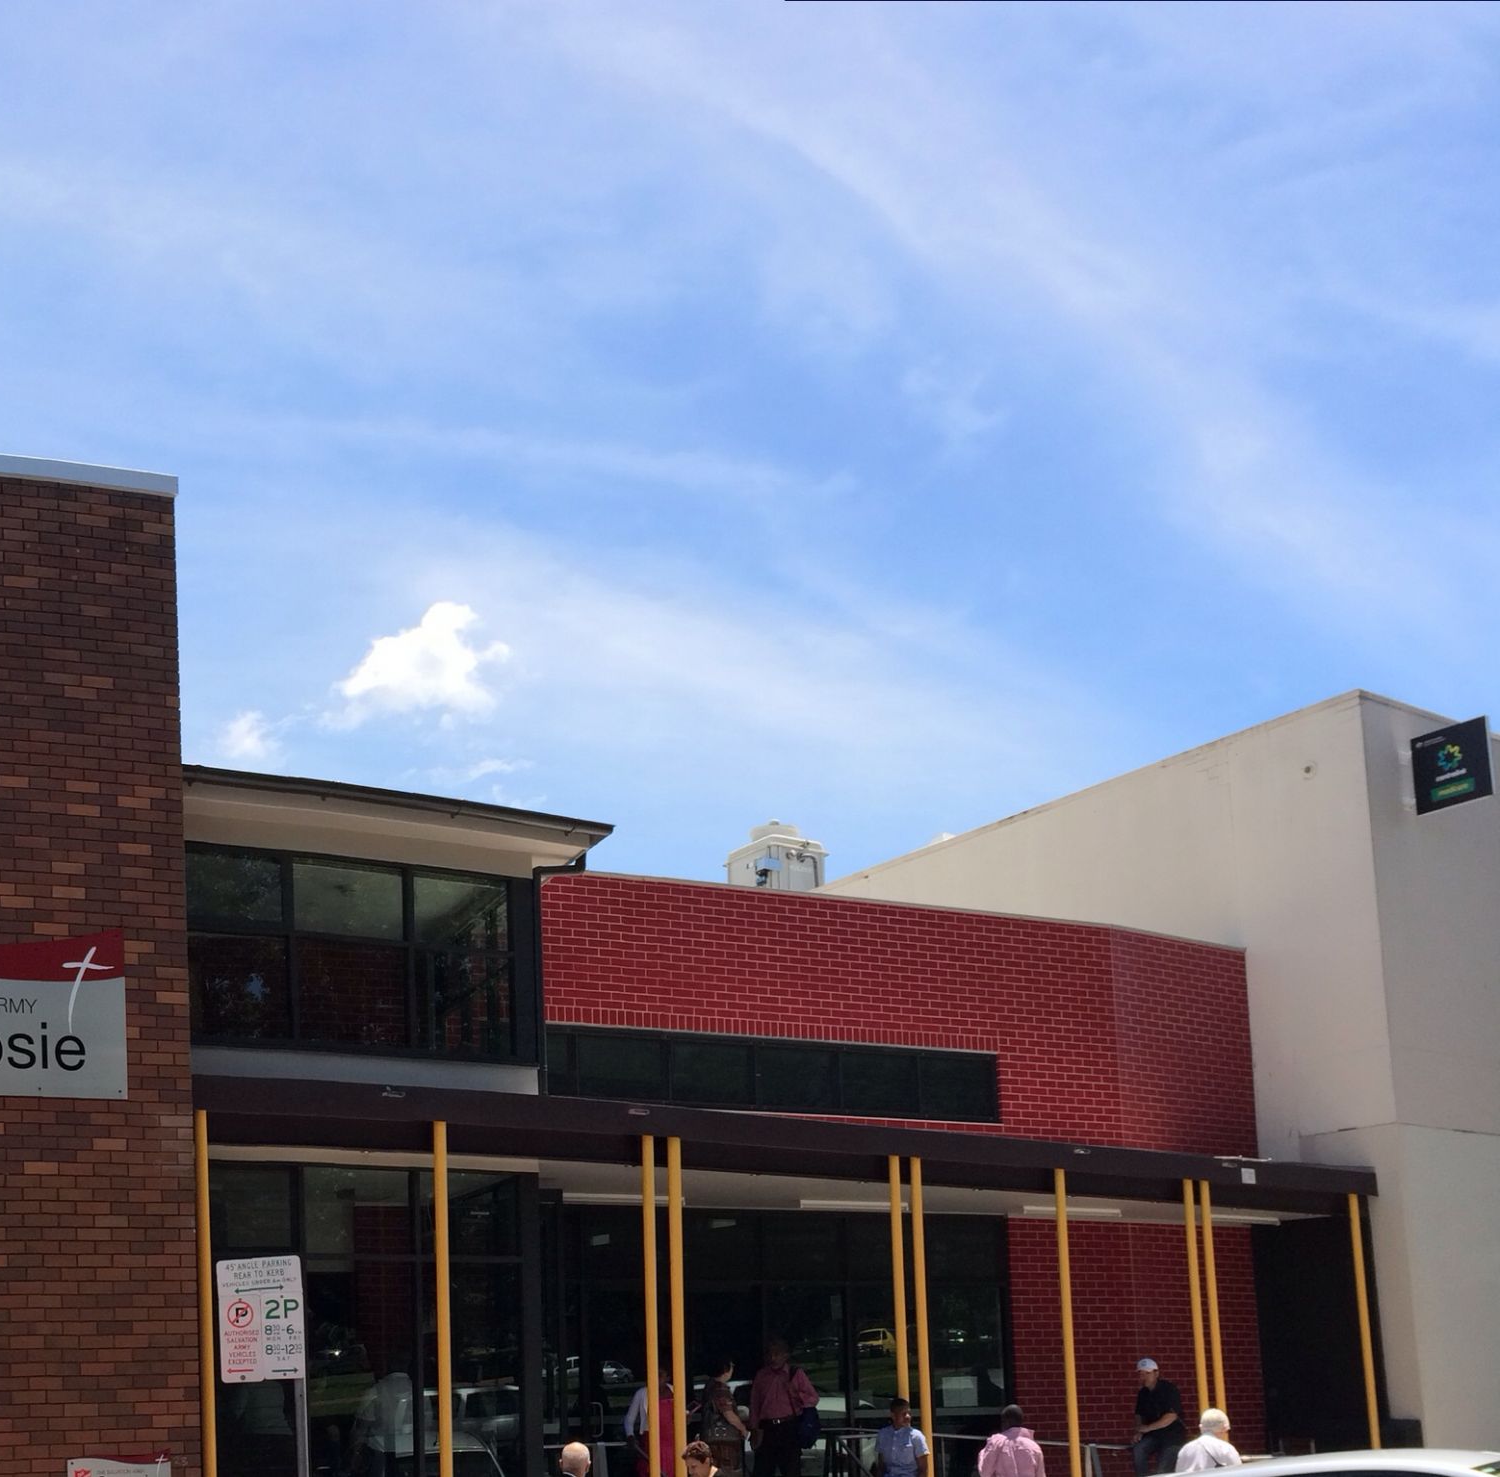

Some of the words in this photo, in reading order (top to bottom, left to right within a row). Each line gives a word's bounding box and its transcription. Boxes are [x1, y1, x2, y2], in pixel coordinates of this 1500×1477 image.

[261, 1259, 292, 1268] PARKING
[233, 1272, 252, 1280] REAR
[254, 1270, 263, 1278] TO
[266, 1269, 285, 1277] KERB
[264, 1299, 299, 1319] 2P
